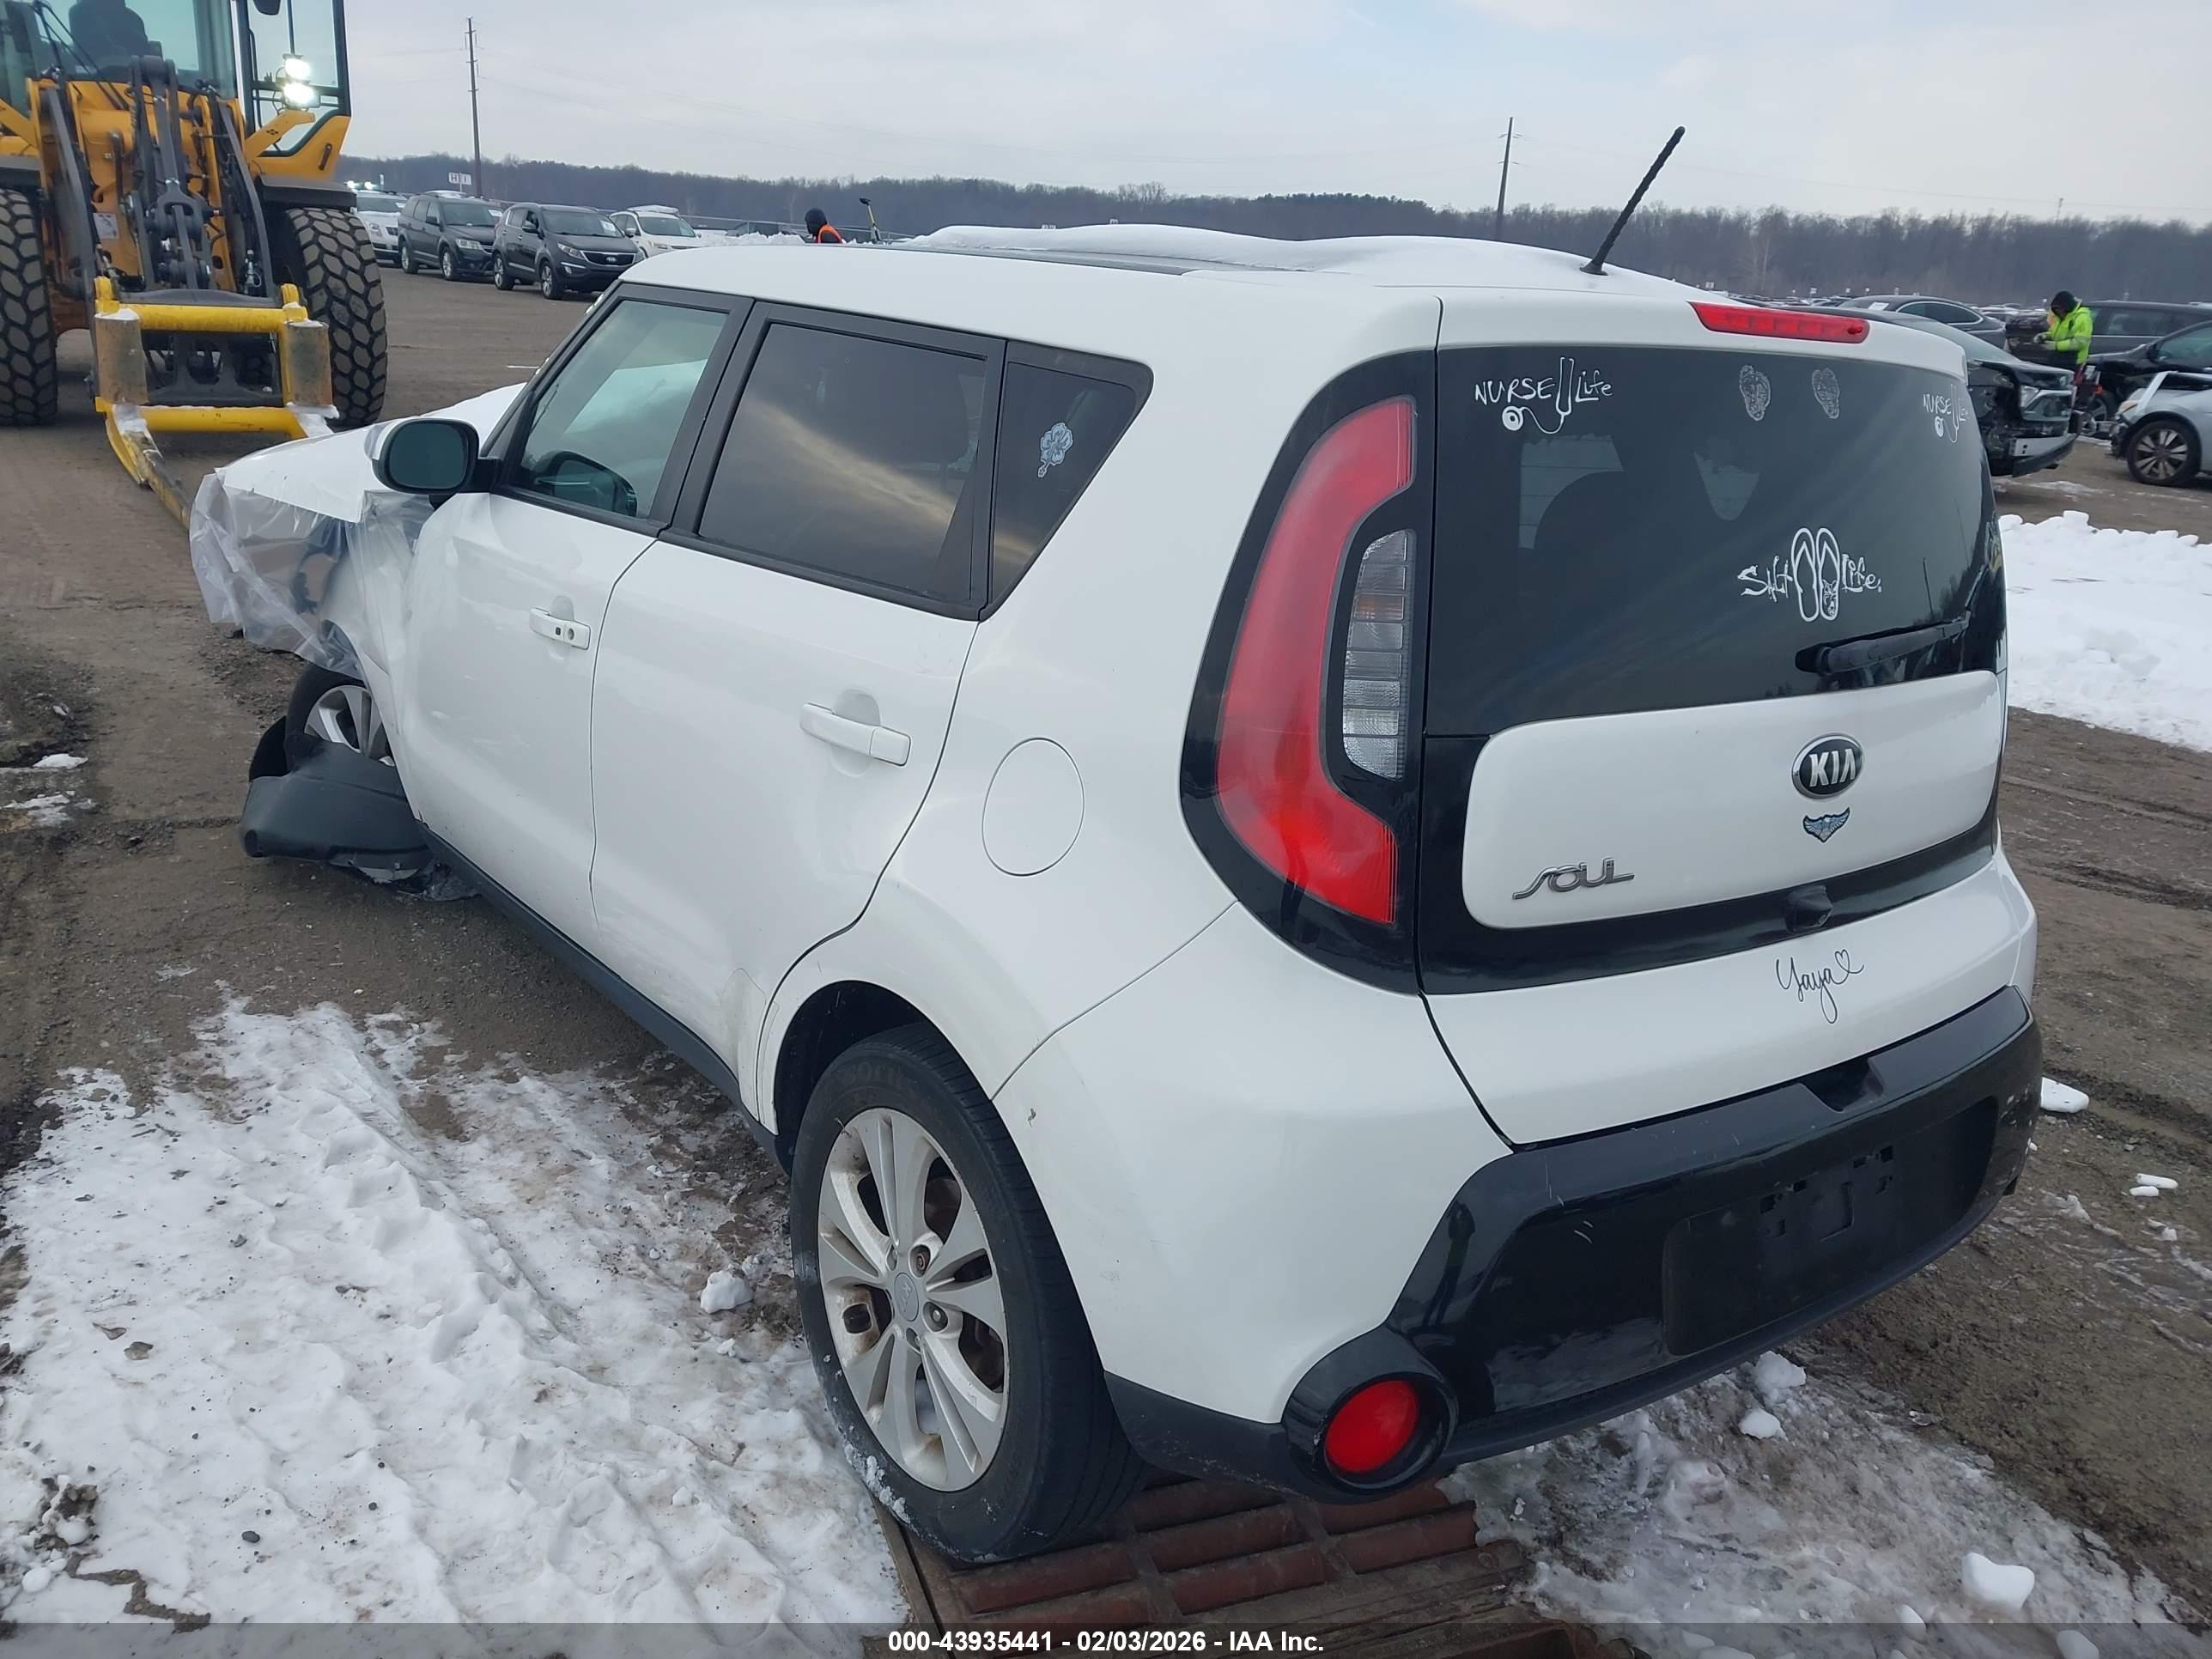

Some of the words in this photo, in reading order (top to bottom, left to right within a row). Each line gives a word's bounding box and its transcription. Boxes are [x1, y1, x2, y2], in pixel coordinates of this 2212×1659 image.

[1475, 378, 1555, 405] NURSE
[1575, 370, 1613, 402] Life
[1923, 393, 1951, 414] NURSE
[1809, 748, 1856, 787] KIA
[1776, 957, 1838, 1024] Yaya
